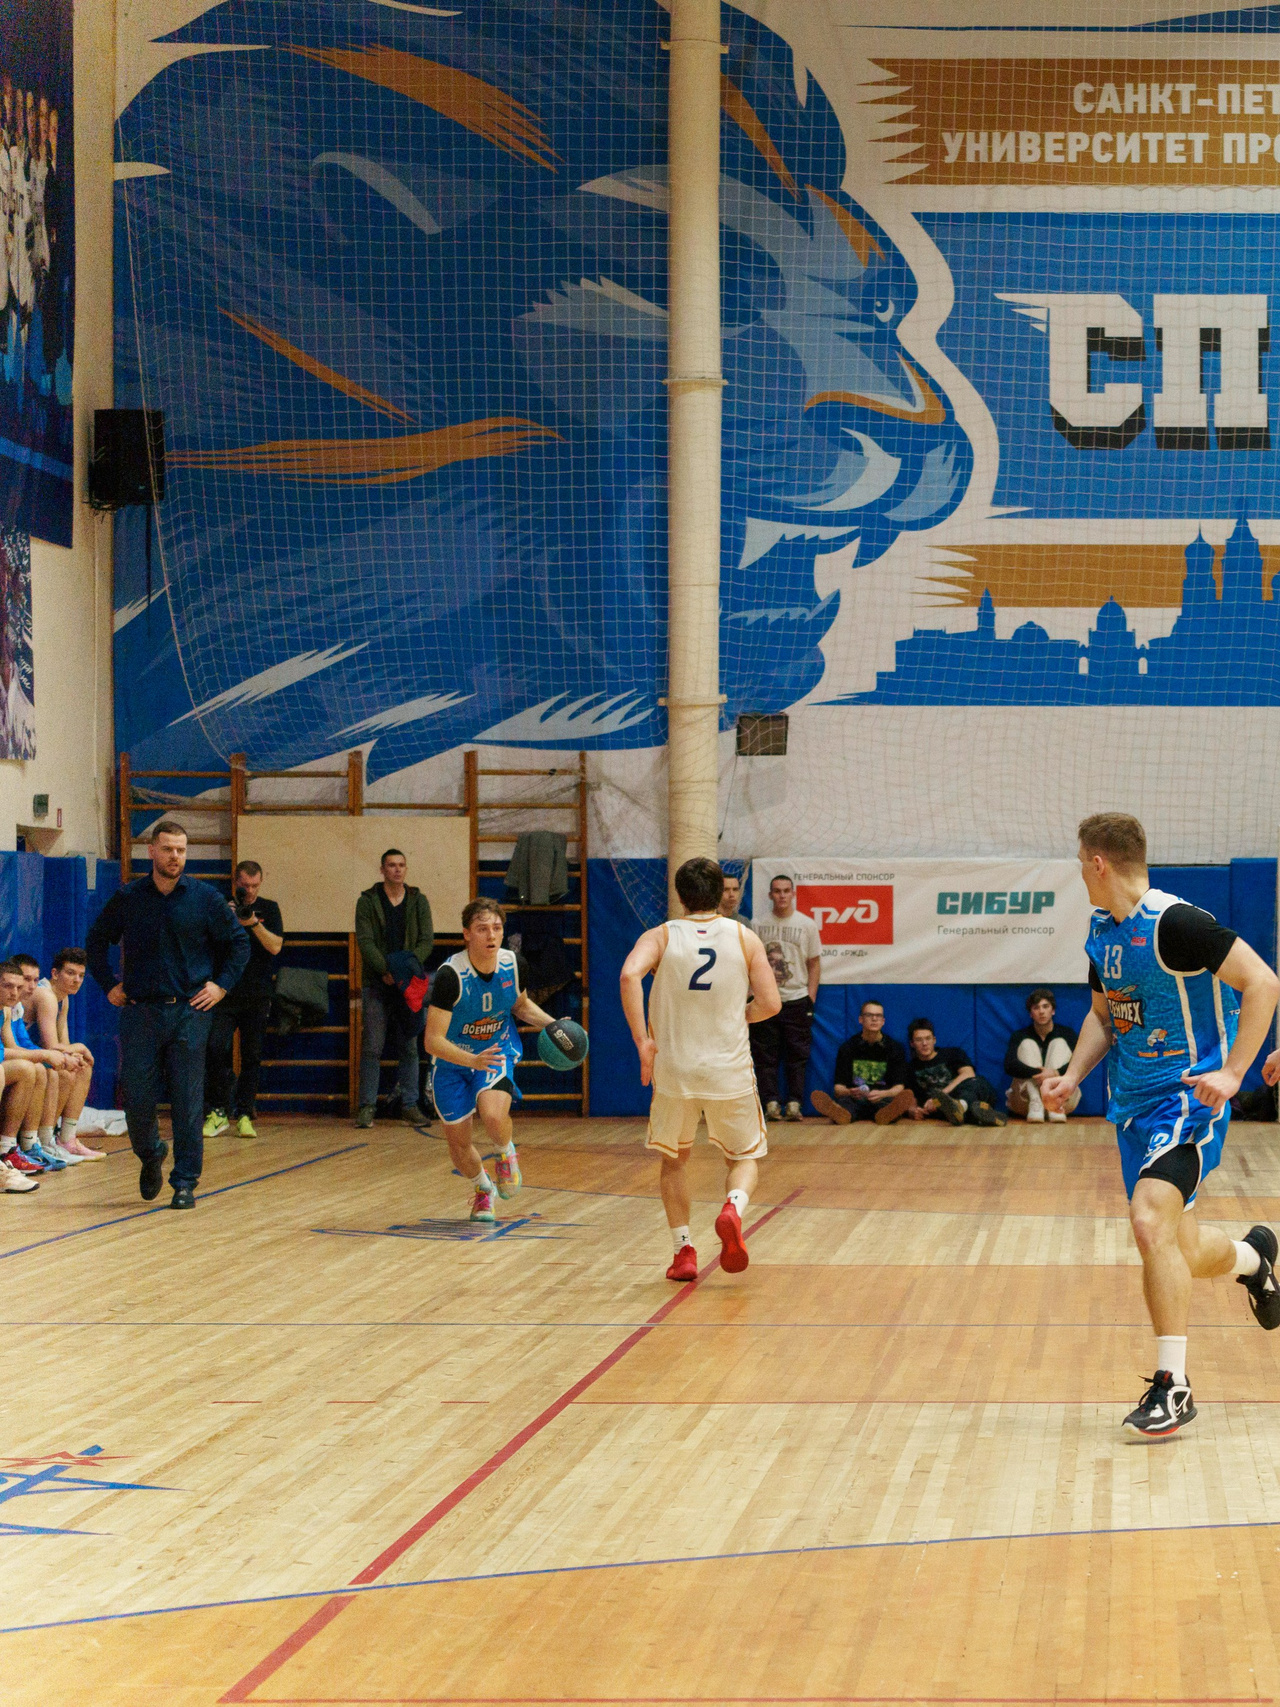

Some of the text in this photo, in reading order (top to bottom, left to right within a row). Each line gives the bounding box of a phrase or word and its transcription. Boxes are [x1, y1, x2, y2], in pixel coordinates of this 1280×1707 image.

[942, 131, 1209, 164] УНИВЕРСИТЕТ
[793, 871, 895, 882] ГЕНЕРАЛЬНЫЙ СПОНСОР
[936, 891, 1056, 915] СИБУР
[937, 925, 1055, 937] Генеральный спонсор
[688, 948, 717, 991] 2
[1103, 945, 1123, 979] 13
